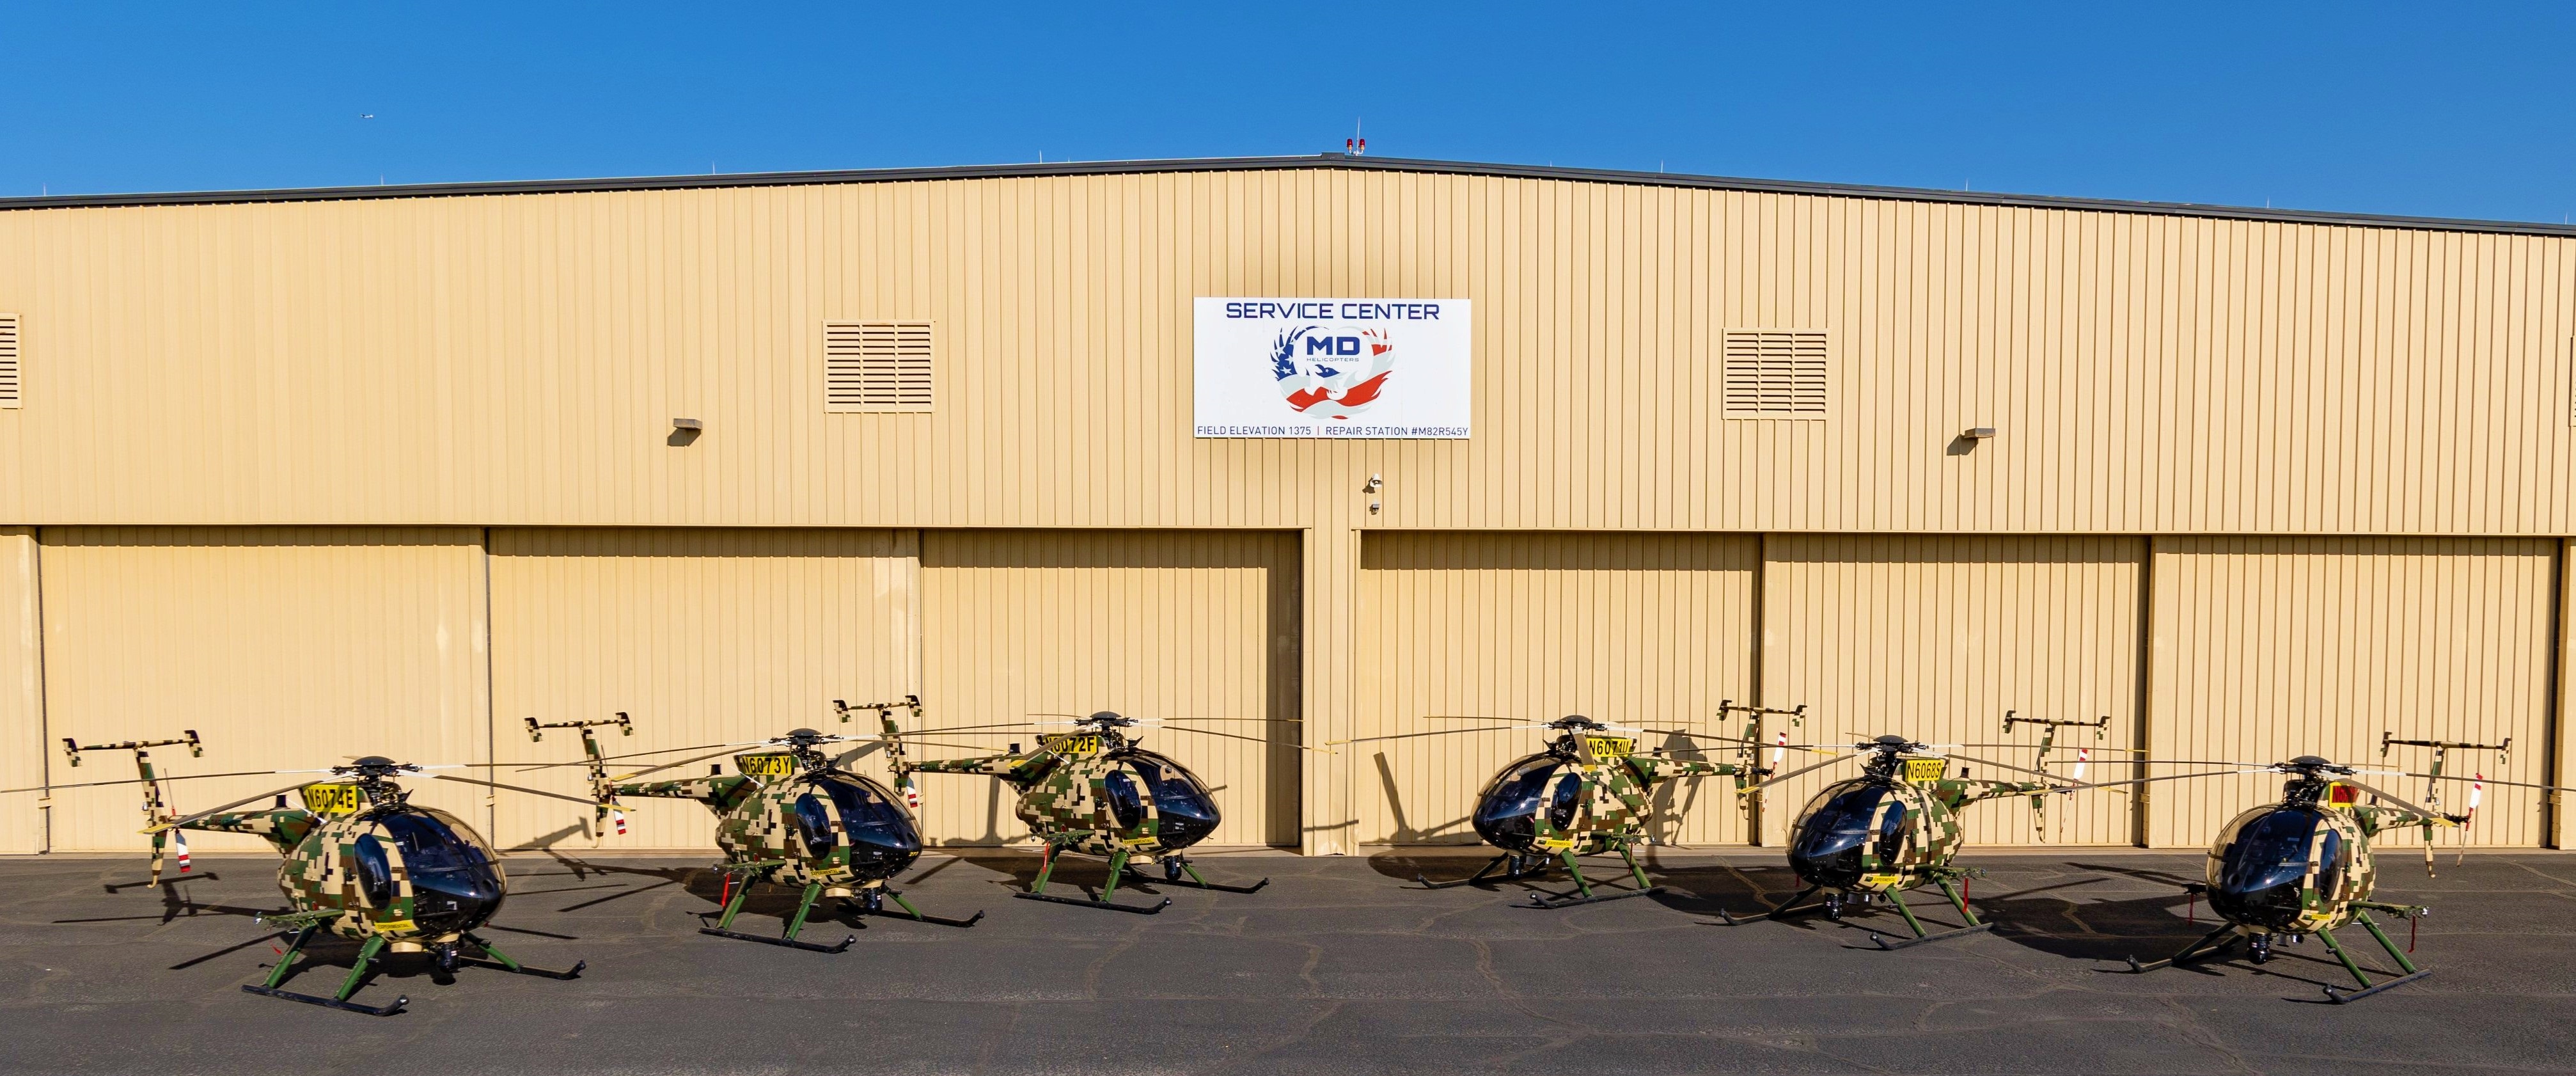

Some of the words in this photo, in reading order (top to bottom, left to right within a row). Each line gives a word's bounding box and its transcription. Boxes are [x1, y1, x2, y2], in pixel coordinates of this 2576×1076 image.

[1226, 303, 1334, 319] SERVICE
[1342, 303, 1440, 320] CENTER
[1307, 336, 1360, 356] MD
[1197, 426, 1227, 435] FIELD
[1230, 426, 1285, 435] ELEVATION
[1289, 426, 1311, 435] 1375
[1326, 426, 1362, 436] REPAIR
[1365, 427, 1408, 436] STATION
[1411, 427, 1468, 436] #M82R545Y
[1589, 740, 1629, 755] N6071U
[742, 757, 790, 774] N6073Y
[1907, 762, 1942, 779] N6068S
[307, 788, 354, 809] N6074E
